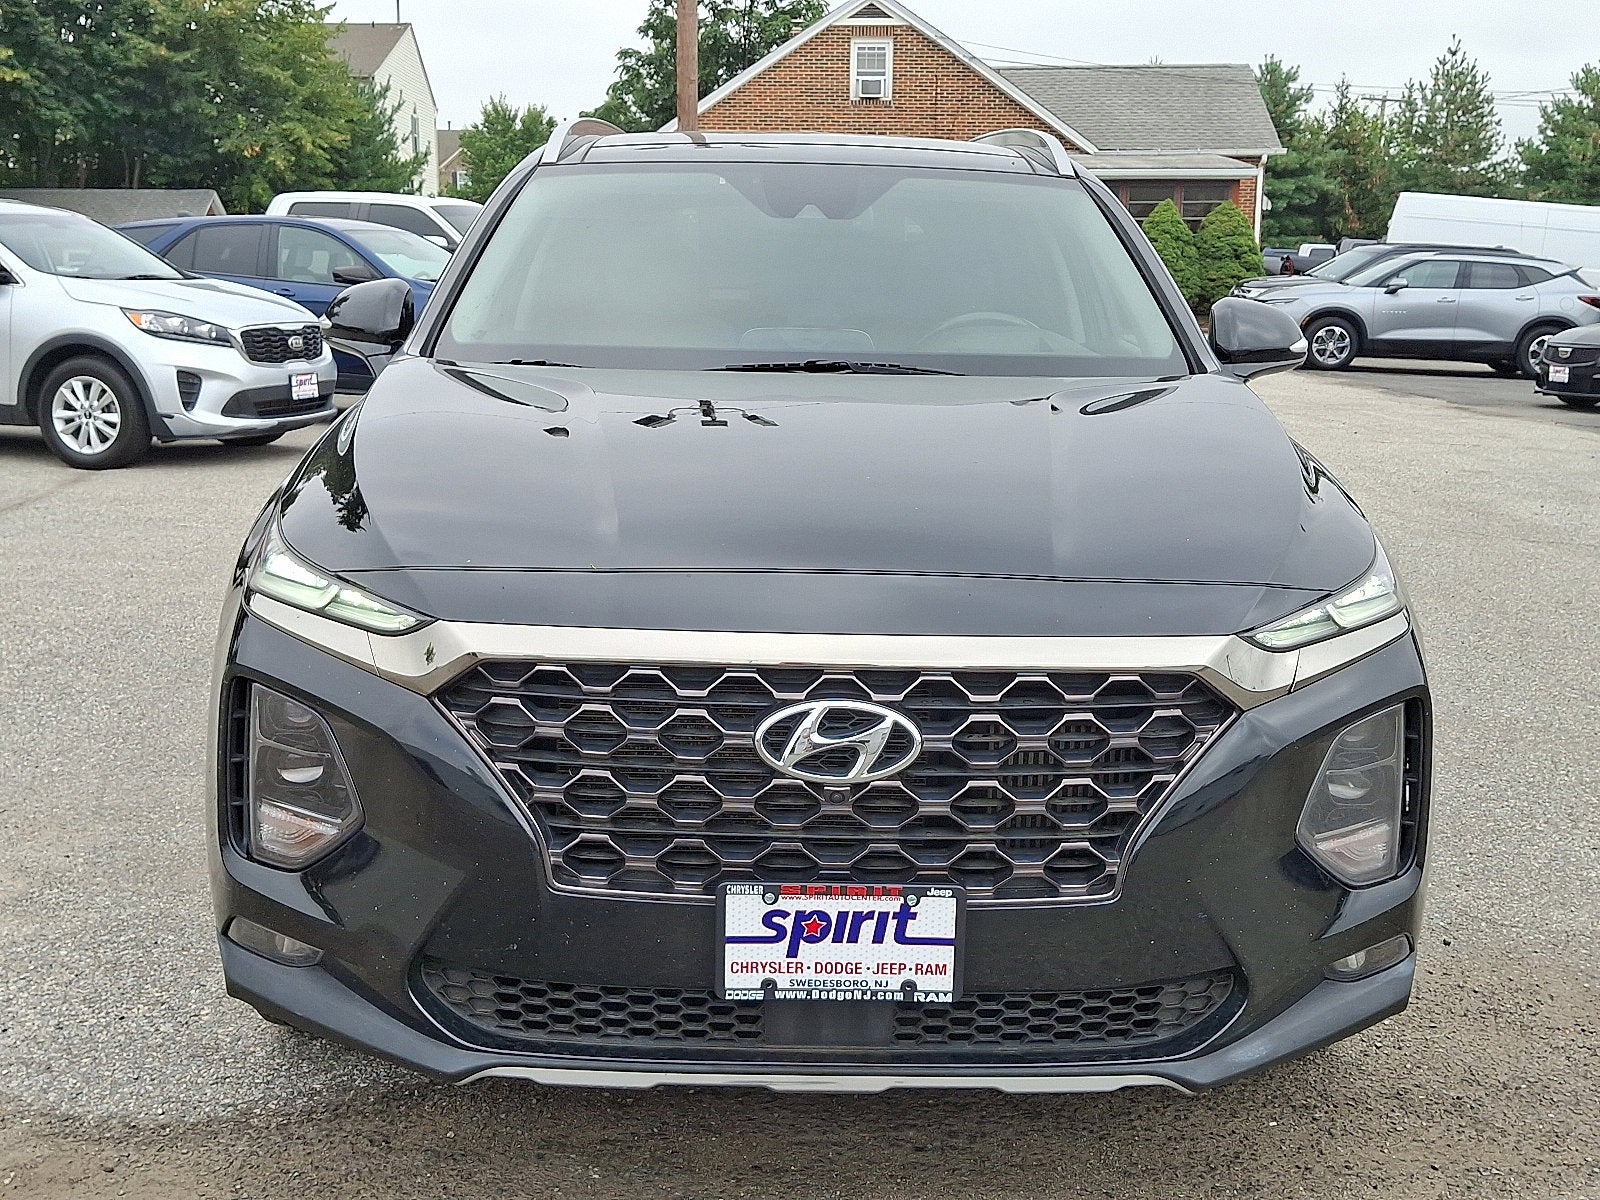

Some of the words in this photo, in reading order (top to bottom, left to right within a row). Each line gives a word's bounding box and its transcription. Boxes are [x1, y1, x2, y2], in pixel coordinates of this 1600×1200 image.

[726, 885, 764, 895] CHRYSLER
[780, 884, 903, 896] SPIRIT
[926, 887, 953, 897] Jeep
[761, 903, 918, 958] spirit
[730, 961, 804, 974] CHRYSLER
[814, 962, 863, 975] DODGE
[872, 963, 907, 975] JEEP
[914, 963, 947, 976] RAM
[789, 979, 871, 989] SWEDESBORO,
[874, 980, 889, 988] NJ
[725, 990, 765, 1000] DODGE
[774, 989, 904, 1001] www.DodgeNJ.com
[913, 992, 953, 1003] RAM
